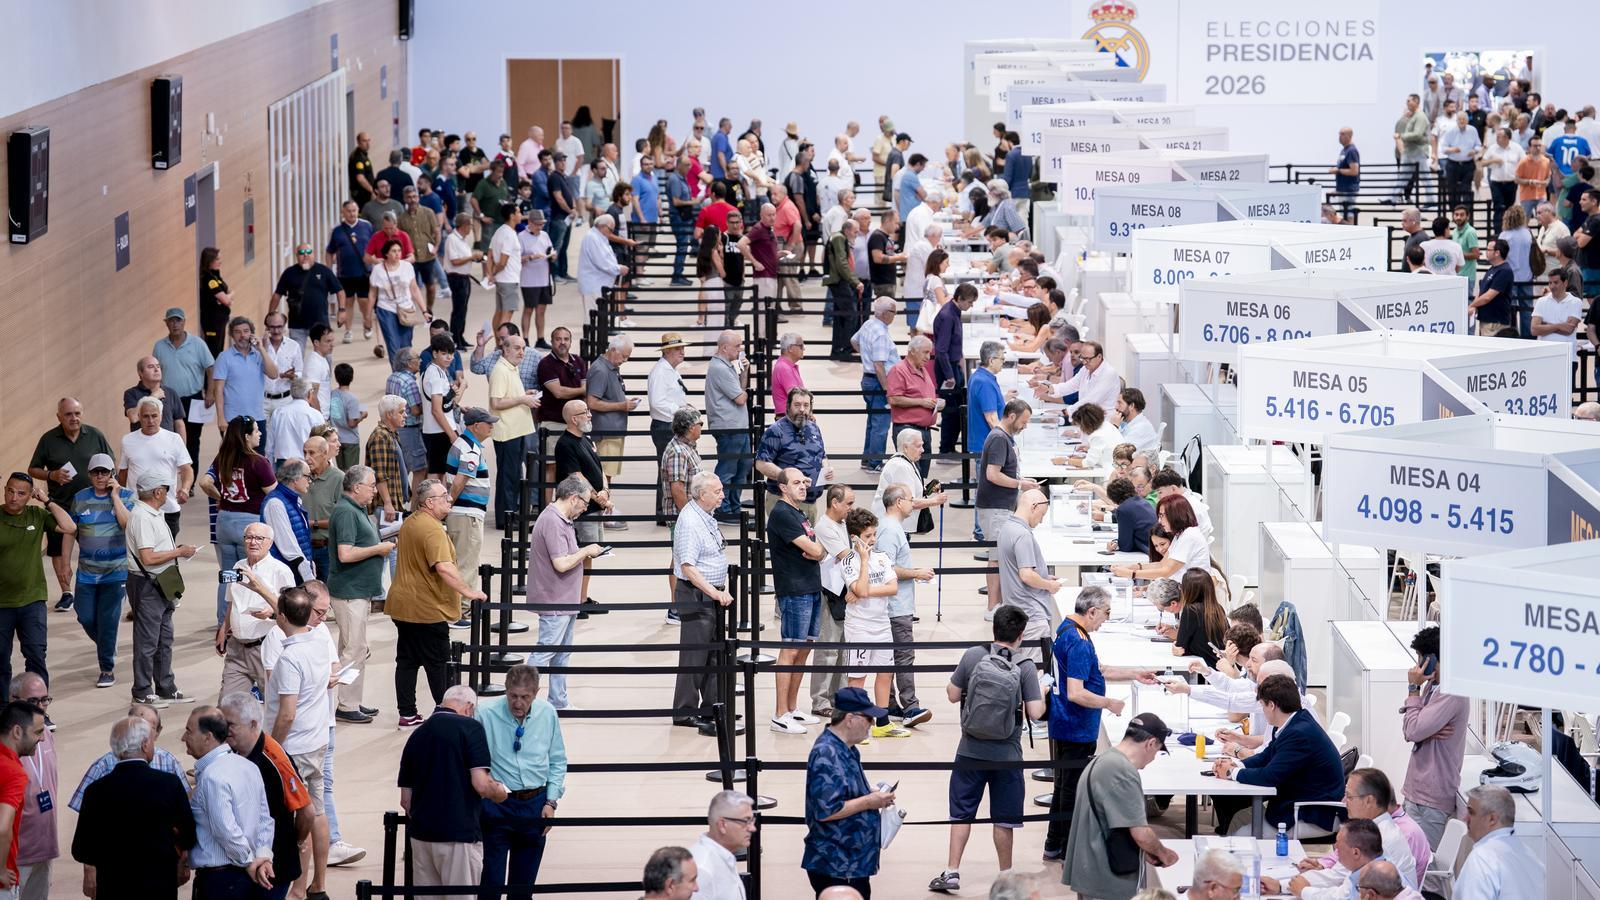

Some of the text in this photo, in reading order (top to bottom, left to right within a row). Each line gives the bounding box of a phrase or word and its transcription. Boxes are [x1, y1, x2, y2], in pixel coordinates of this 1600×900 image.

[1207, 20, 1375, 37] ELECCIONES
[1207, 43, 1373, 61] PRESIDENCIA
[1206, 75, 1265, 95] 2026
[1051, 119, 1074, 127] MESA
[1071, 142, 1110, 152] MESA 10
[1193, 141, 1201, 150] 21
[1096, 171, 1139, 183] MESA 09
[1201, 170, 1239, 181] MESA 22
[1132, 204, 1181, 218] MESA 08
[1249, 203, 1290, 217] MESA 23
[1174, 249, 1229, 264] MESA 07
[1306, 248, 1351, 263] MESA 24
[1227, 301, 1290, 320] MESA 06
[1377, 300, 1428, 319] MESA 25
[1204, 324, 1249, 344] 6.706
[1294, 371, 1367, 393] MESA 05
[1467, 370, 1527, 392] MESA 26
[1266, 396, 1319, 420] 5.416
[1340, 403, 1394, 426] 6.705
[1391, 465, 1480, 492] MESA 04
[1358, 495, 1422, 524] 4.098
[1448, 504, 1513, 534] 5.415
[1525, 603, 1600, 635] MESA
[1483, 638, 1564, 675] 2.780
